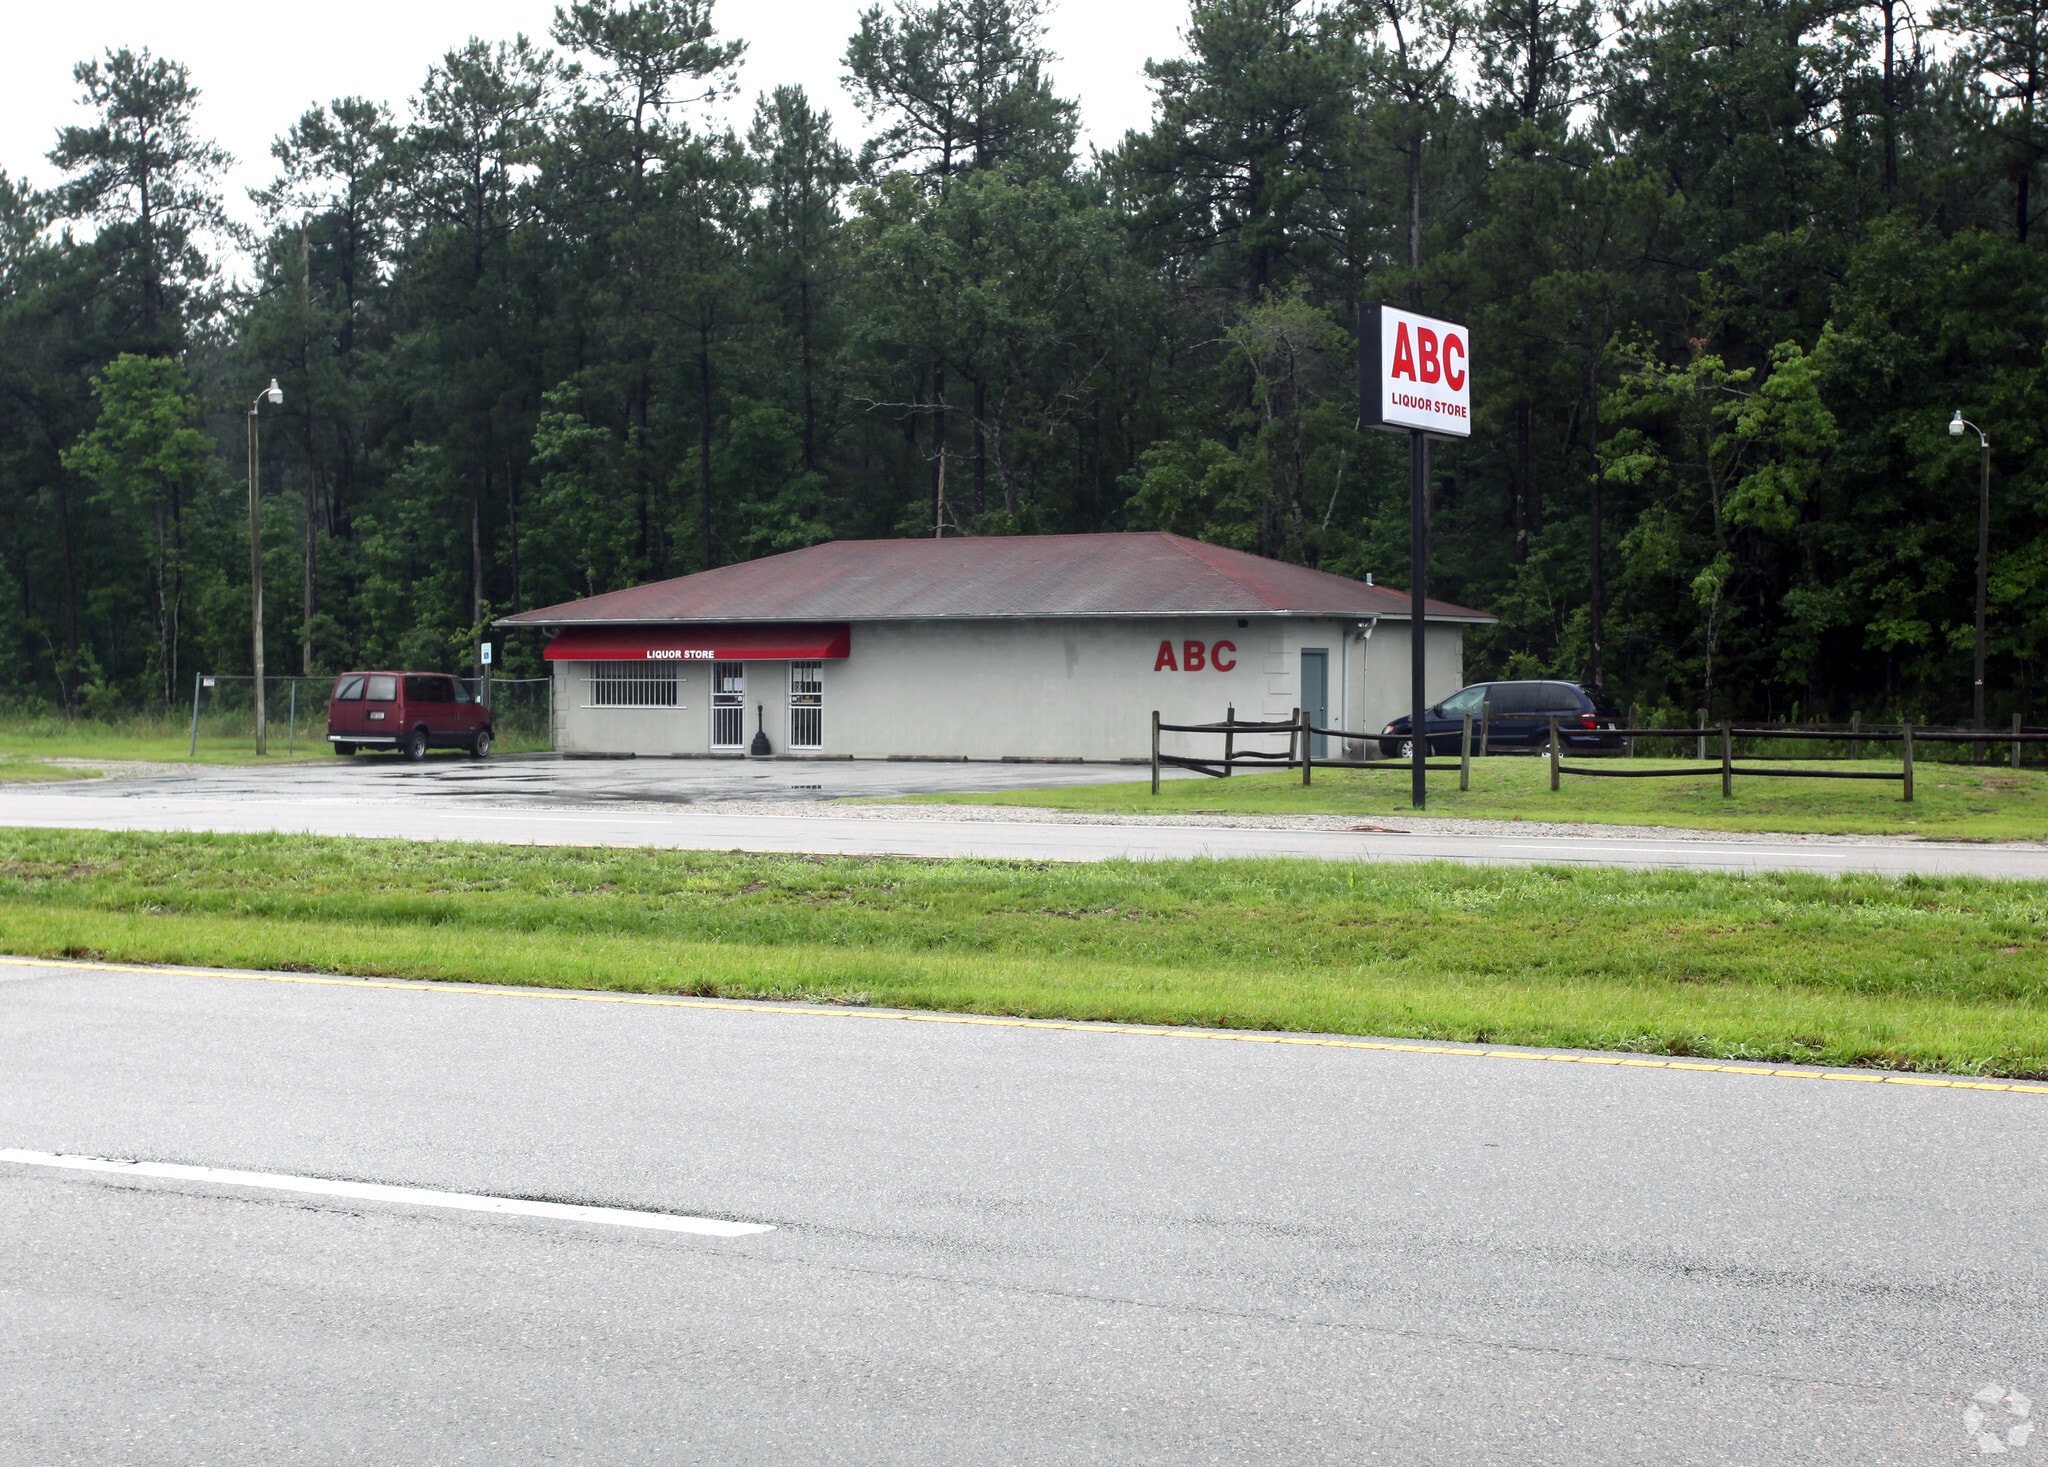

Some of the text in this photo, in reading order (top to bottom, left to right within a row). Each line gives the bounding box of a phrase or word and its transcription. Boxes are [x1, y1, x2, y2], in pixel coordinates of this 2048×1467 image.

[1391, 321, 1465, 391] ABC
[1391, 392, 1467, 418] LIQUOR STORE
[646, 650, 715, 659] LIQUOR STORE
[1154, 640, 1237, 672] ABC
